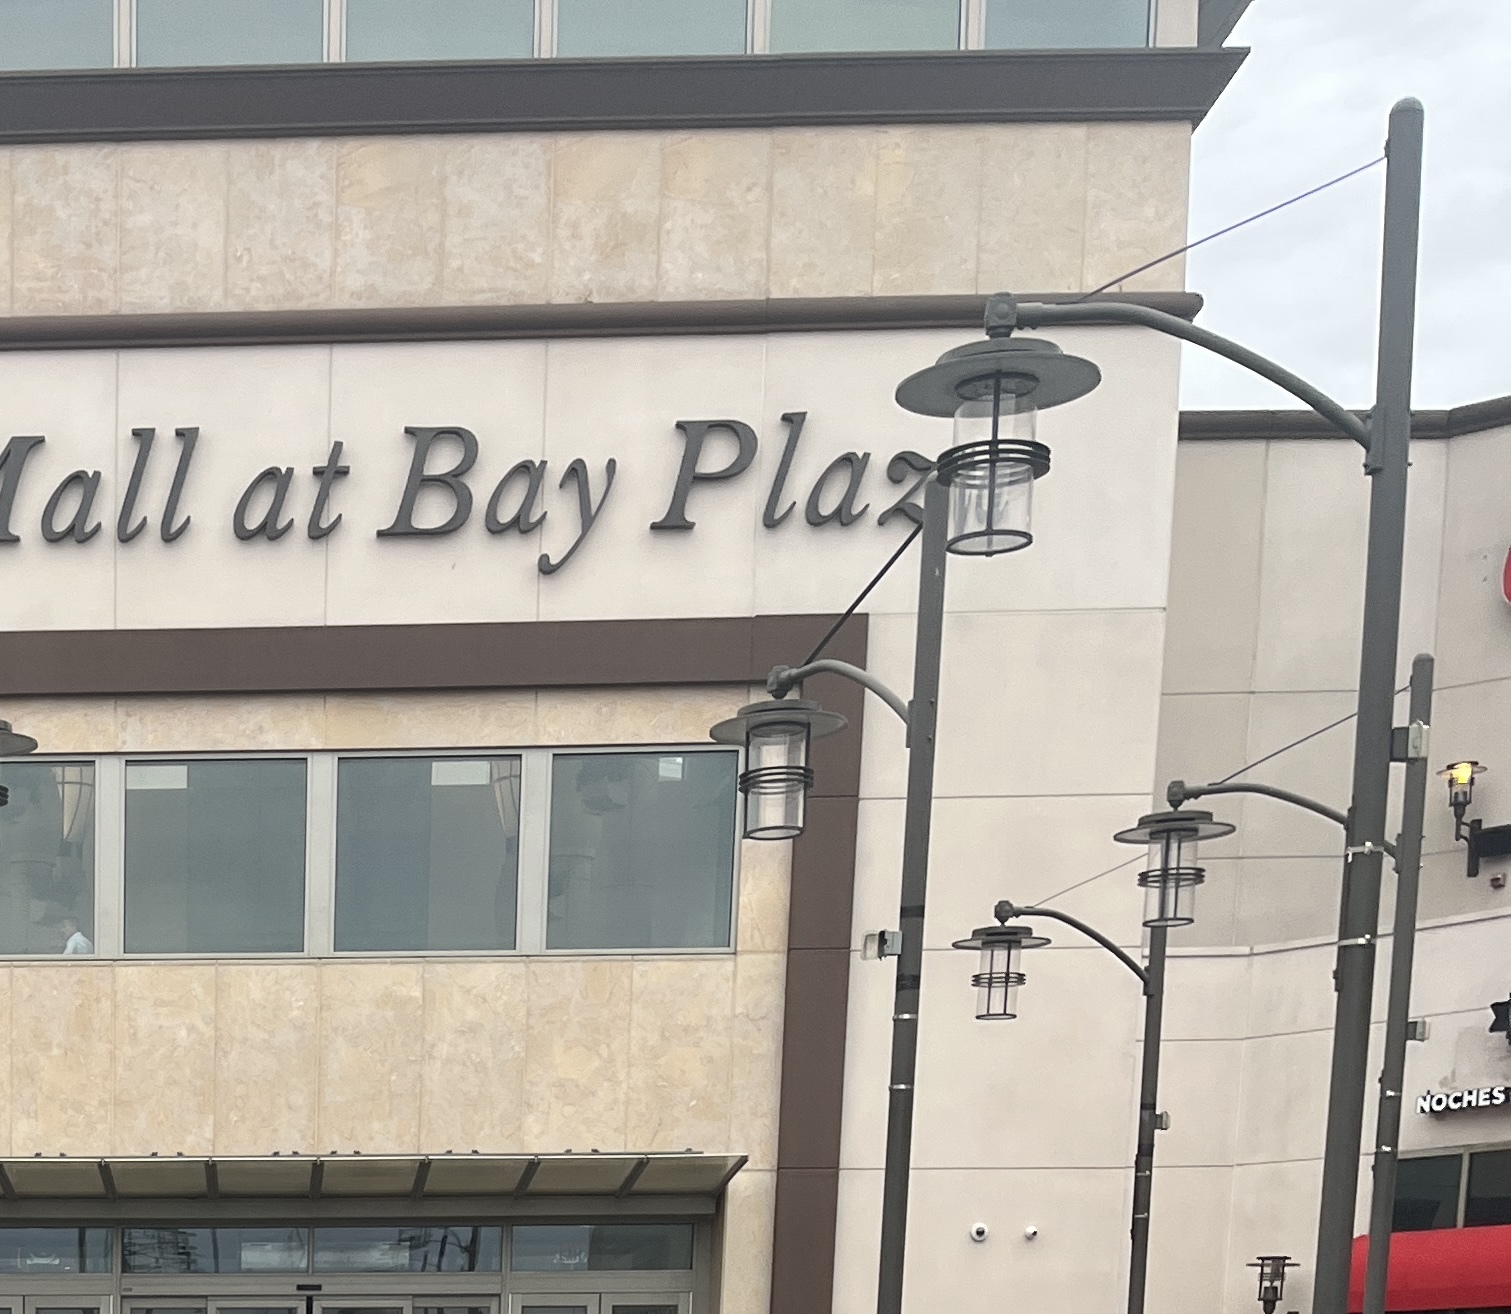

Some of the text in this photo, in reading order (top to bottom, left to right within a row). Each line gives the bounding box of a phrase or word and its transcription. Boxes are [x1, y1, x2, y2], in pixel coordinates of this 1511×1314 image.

[232, 441, 351, 541] at
[376, 425, 618, 575] Bay
[649, 411, 938, 531] Plaz
[1415, 1086, 1506, 1114] NOCHES
